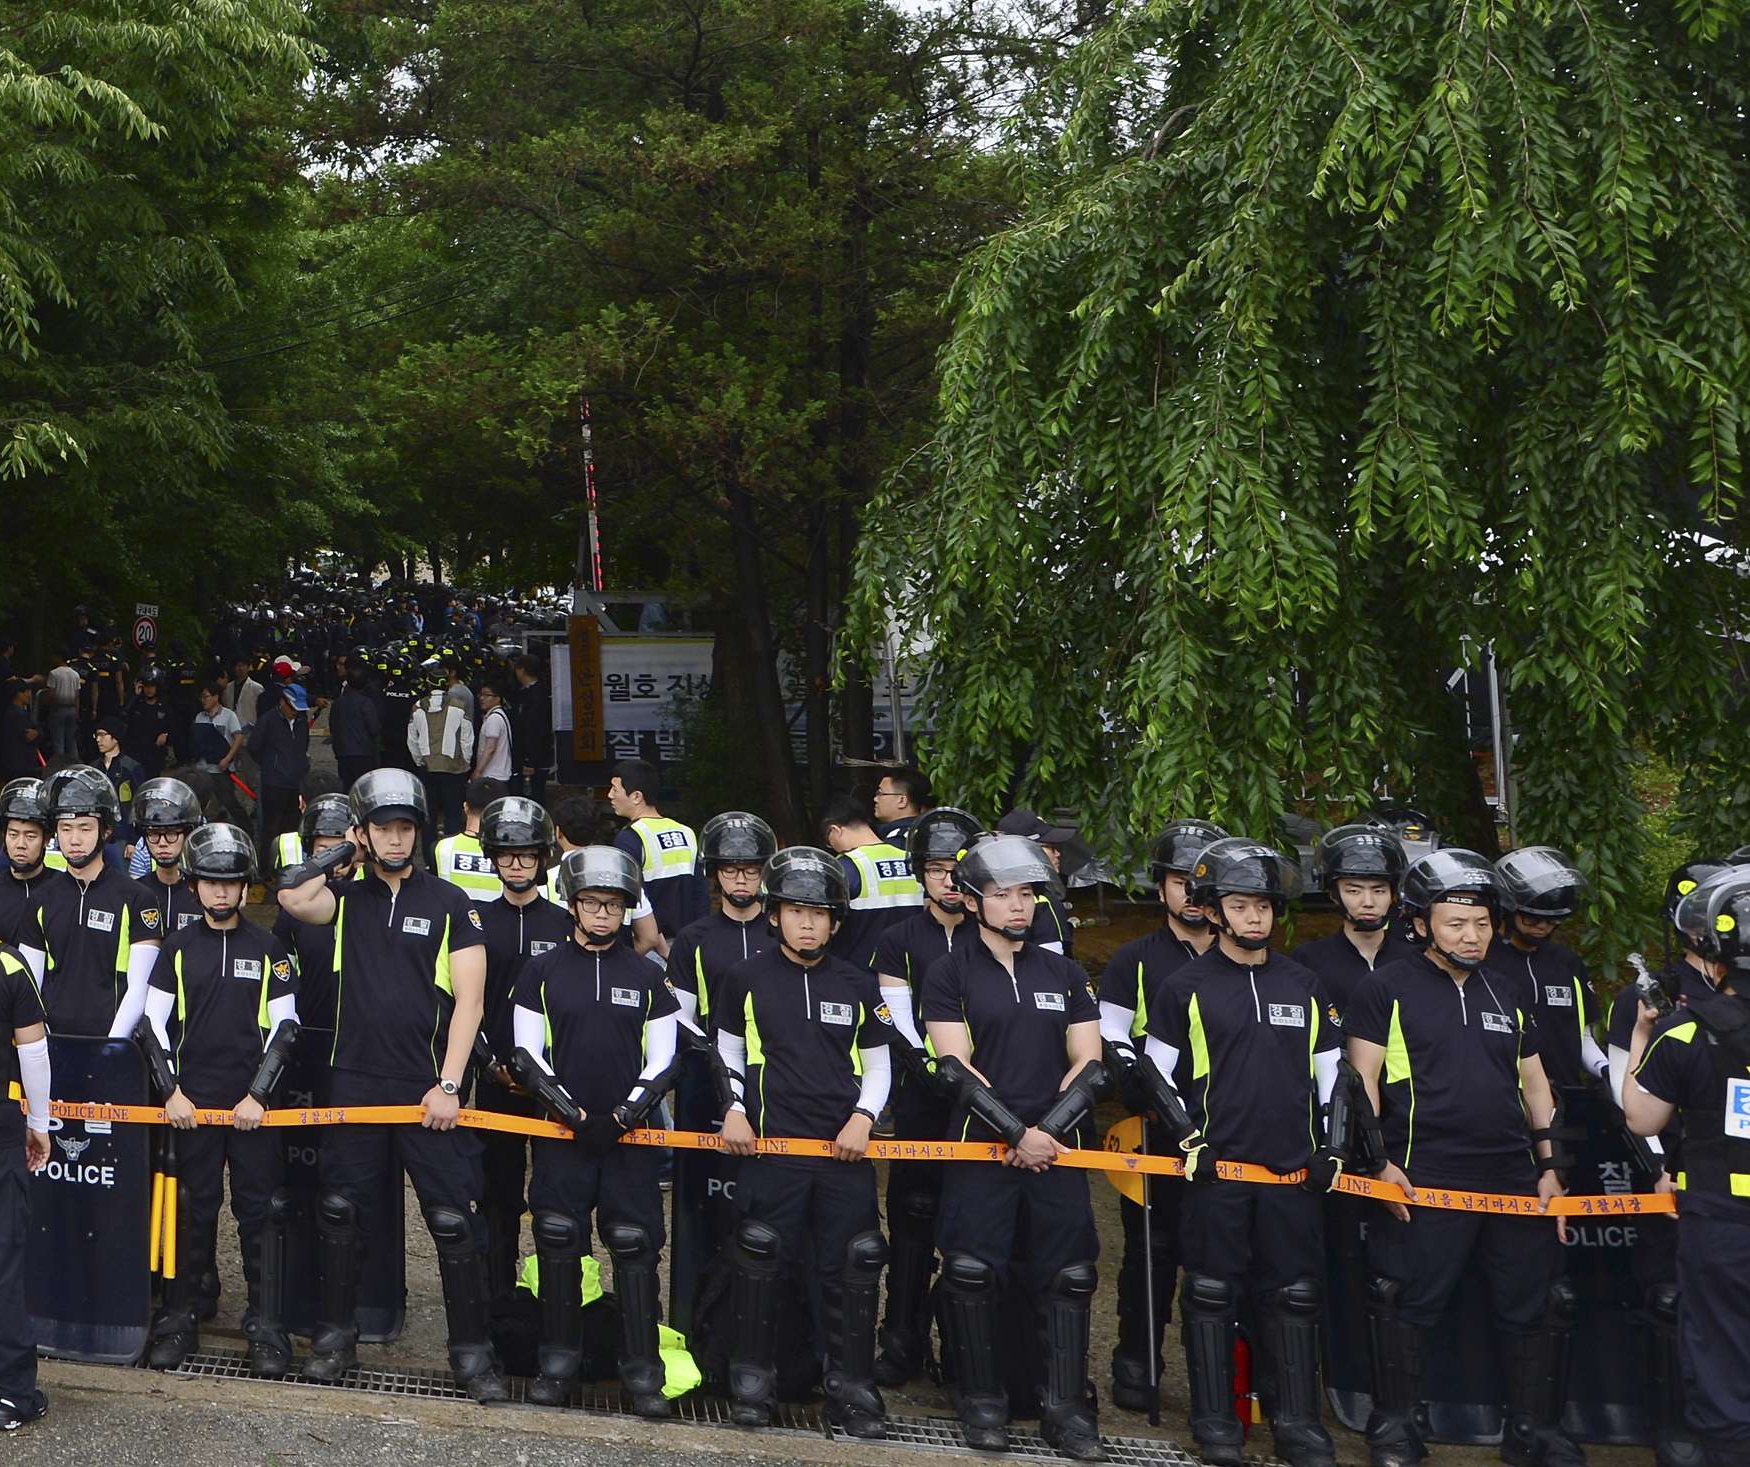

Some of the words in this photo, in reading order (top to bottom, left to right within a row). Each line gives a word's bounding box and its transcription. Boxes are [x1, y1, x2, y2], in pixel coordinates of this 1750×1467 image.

[138, 625, 152, 642] 20
[603, 673, 660, 702] 월호
[660, 831, 687, 848] 경찰
[879, 861, 907, 876] 경찰
[1446, 896, 1473, 905] POLICE
[51, 1103, 95, 1118] POLICE
[99, 1106, 129, 1120] LINE
[299, 1109, 345, 1125] 경찰서장
[620, 1131, 666, 1145] 유지선
[697, 1134, 725, 1148] POL
[755, 1139, 788, 1153] LINE
[822, 1143, 833, 1154] 이
[876, 1144, 954, 1158] 넘지마시오!
[1337, 1177, 1371, 1195] LINE
[1425, 1191, 1451, 1206] 선을
[1579, 1197, 1642, 1214] 경찰서장
